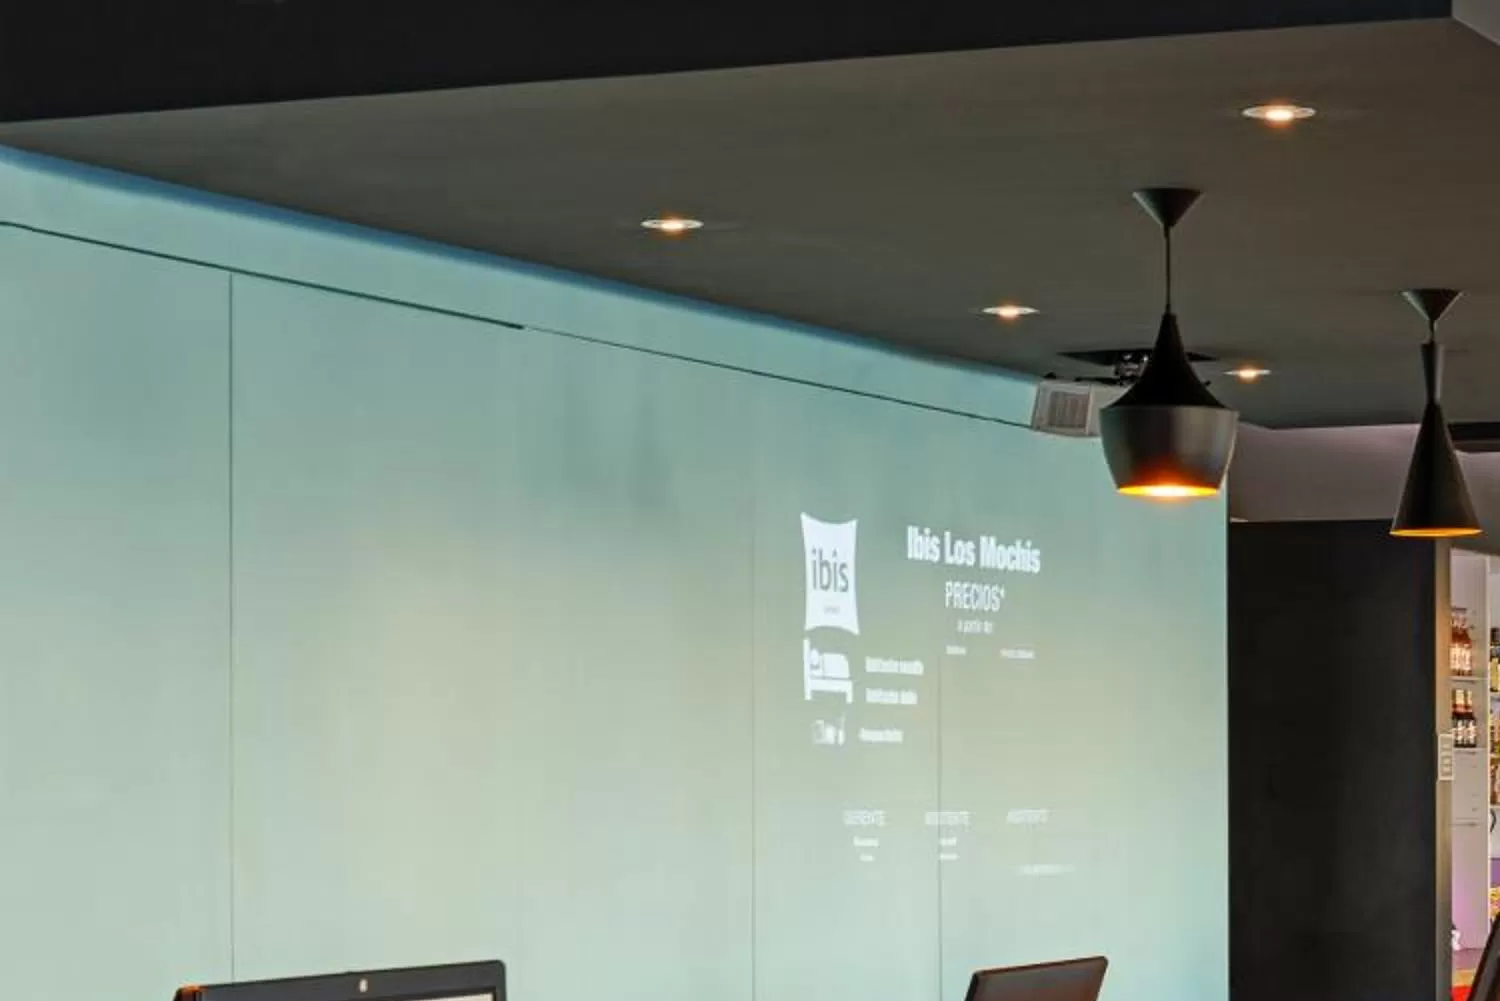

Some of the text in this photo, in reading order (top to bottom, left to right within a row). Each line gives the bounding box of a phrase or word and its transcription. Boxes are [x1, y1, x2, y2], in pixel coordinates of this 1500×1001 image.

[811, 548, 850, 593] ibis
[907, 525, 1041, 574] Ibis Los Mochis
